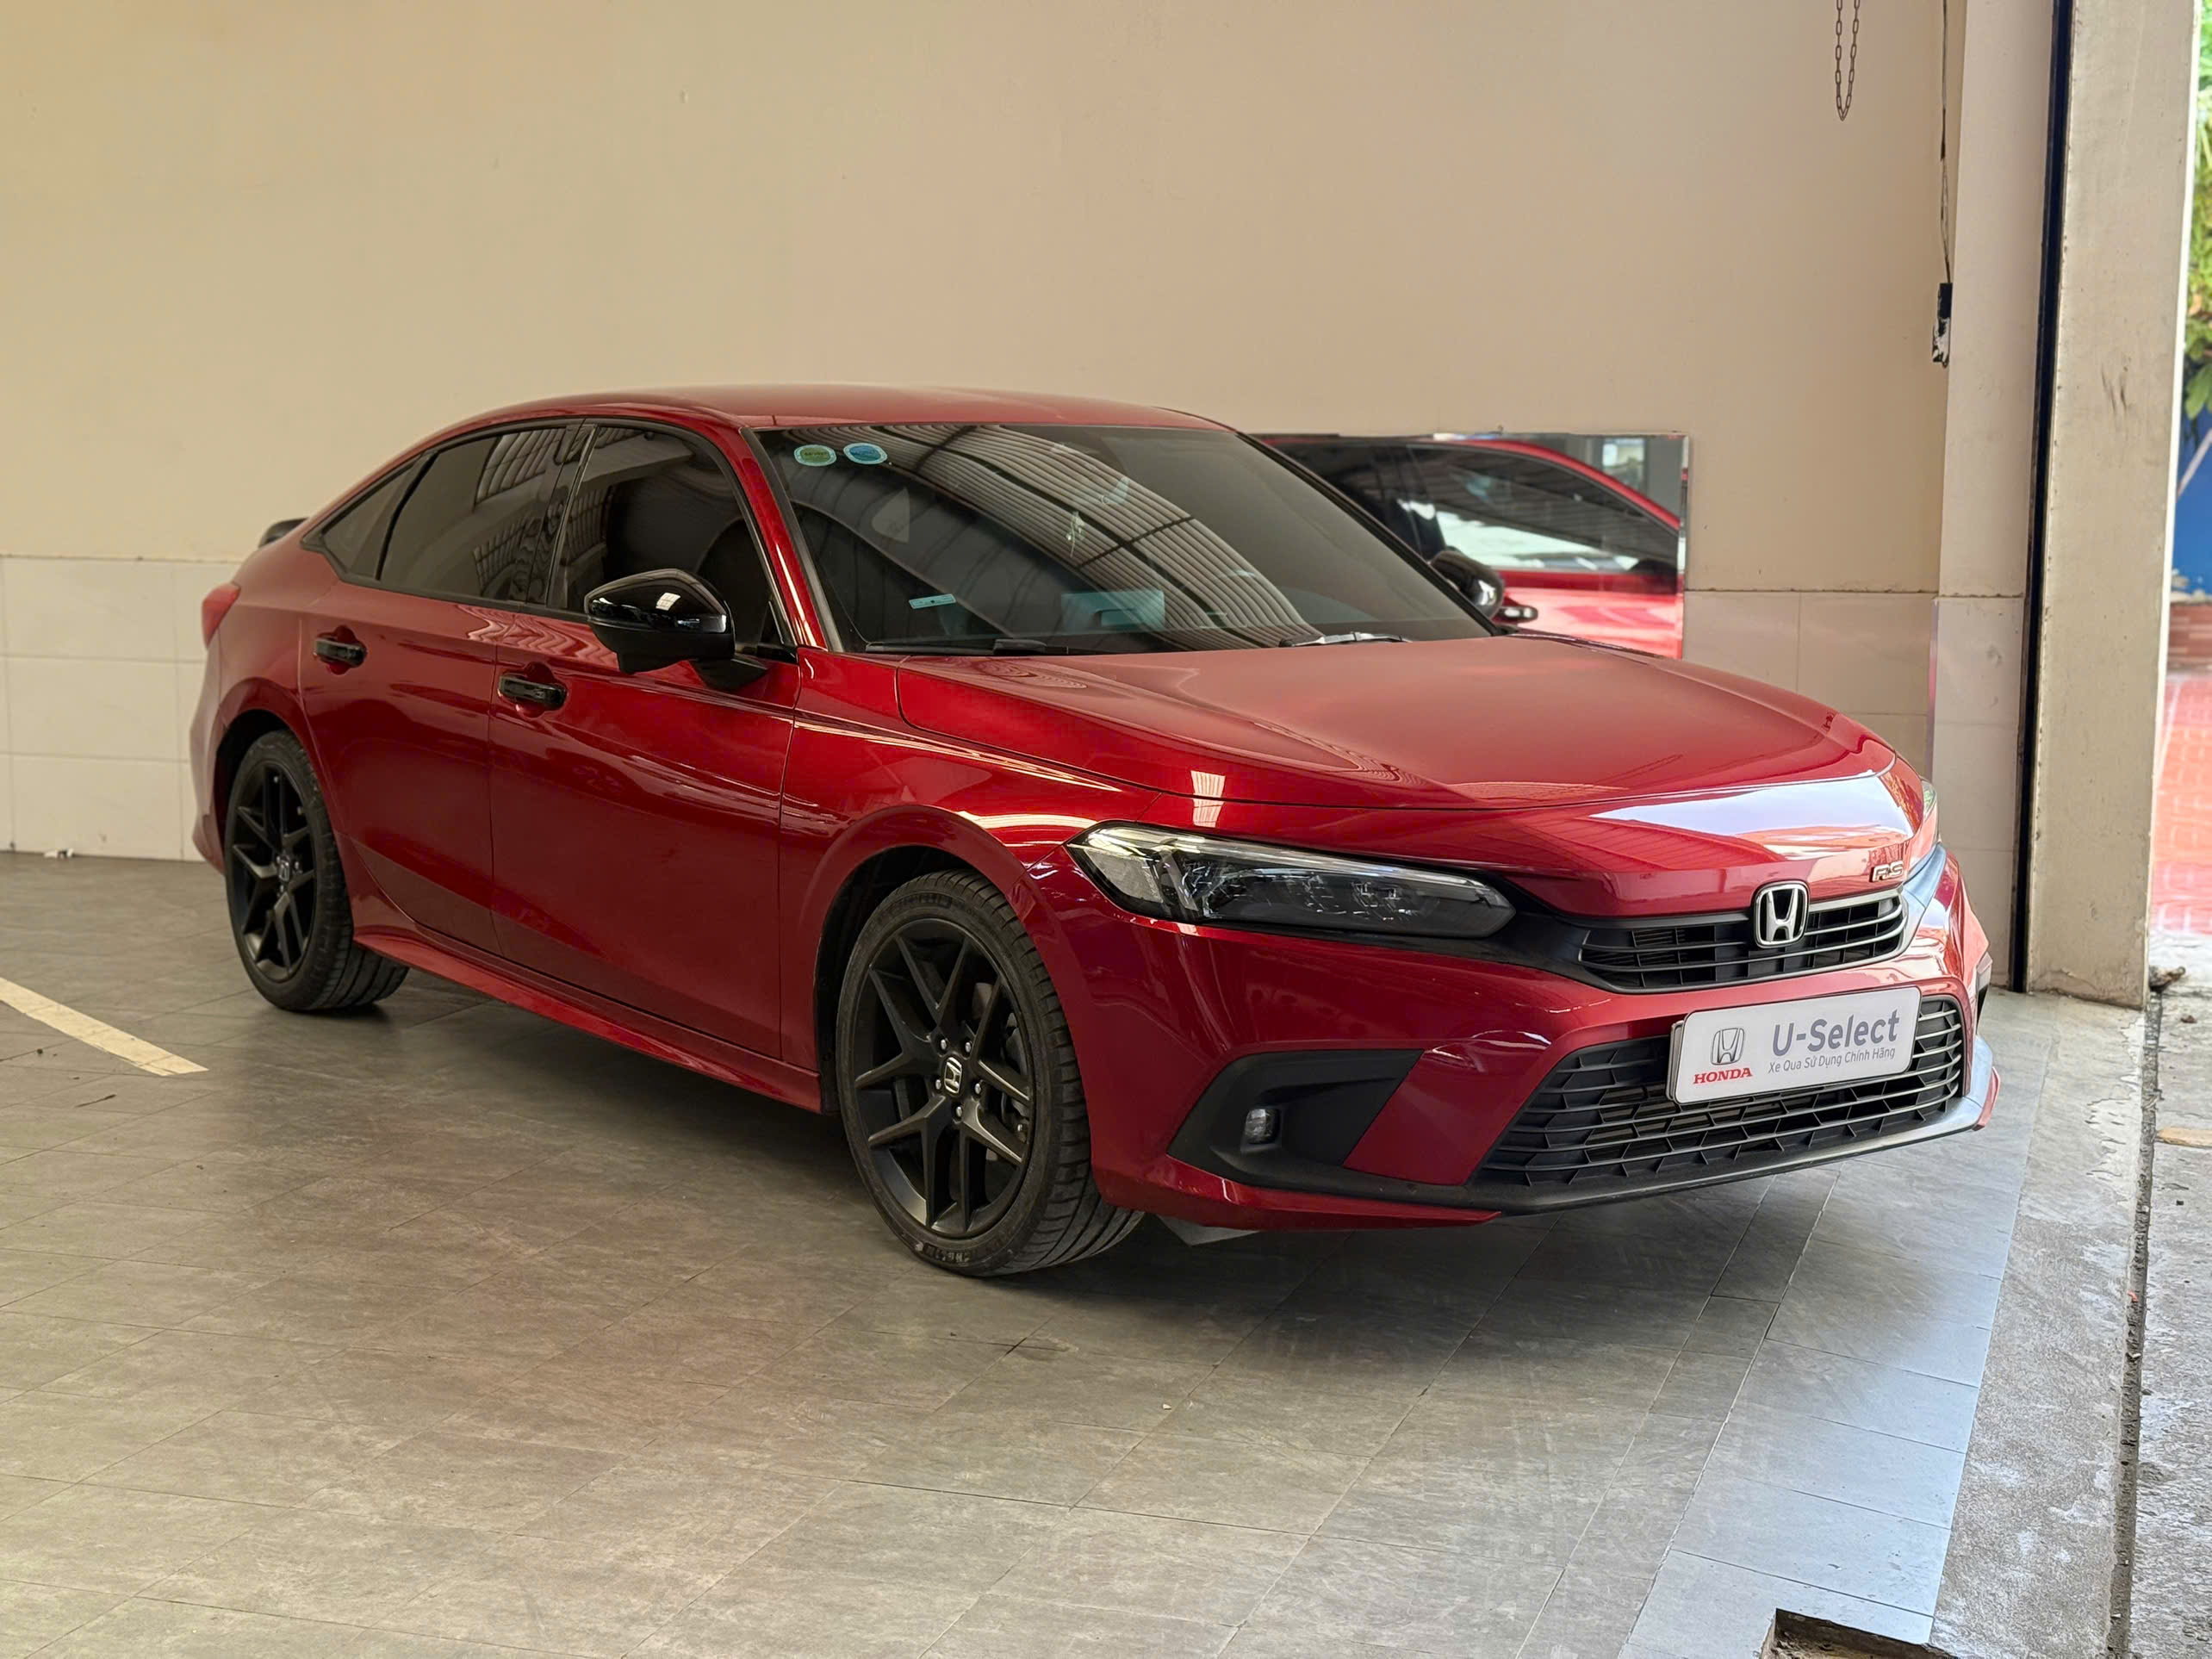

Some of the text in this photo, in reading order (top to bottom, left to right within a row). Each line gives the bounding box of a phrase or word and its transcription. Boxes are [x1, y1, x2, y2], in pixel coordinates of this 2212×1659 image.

[1870, 861, 1904, 882] RS
[1773, 1010, 1899, 1056] U-Select
[1768, 1062, 1781, 1073] Xe
[1783, 1059, 1801, 1070] Qua
[1818, 1055, 1842, 1068] Dụng
[1845, 1050, 1870, 1063] Chính
[1873, 1047, 1895, 1059] Hãng
[1693, 1067, 1752, 1084] HONDA
